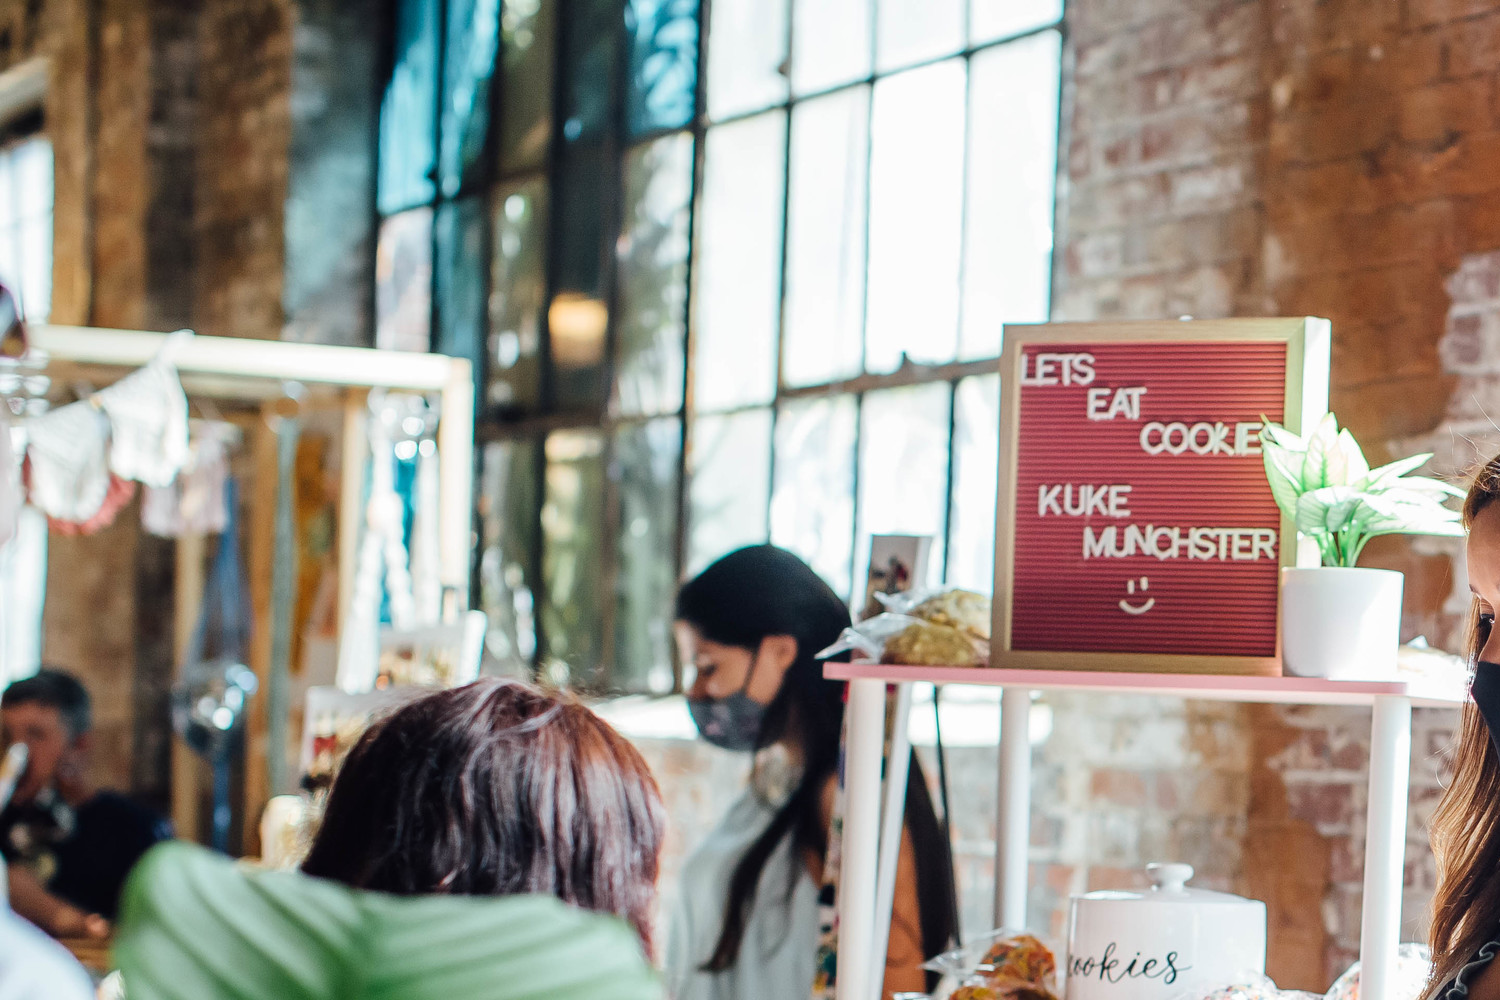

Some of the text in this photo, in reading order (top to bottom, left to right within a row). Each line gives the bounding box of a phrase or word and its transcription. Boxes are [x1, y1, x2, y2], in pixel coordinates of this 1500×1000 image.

[1020, 353, 1096, 387] LETS
[1087, 386, 1148, 421] EAT
[1038, 482, 1133, 518] KUKE
[1083, 524, 1277, 561] MUNCHSTER
